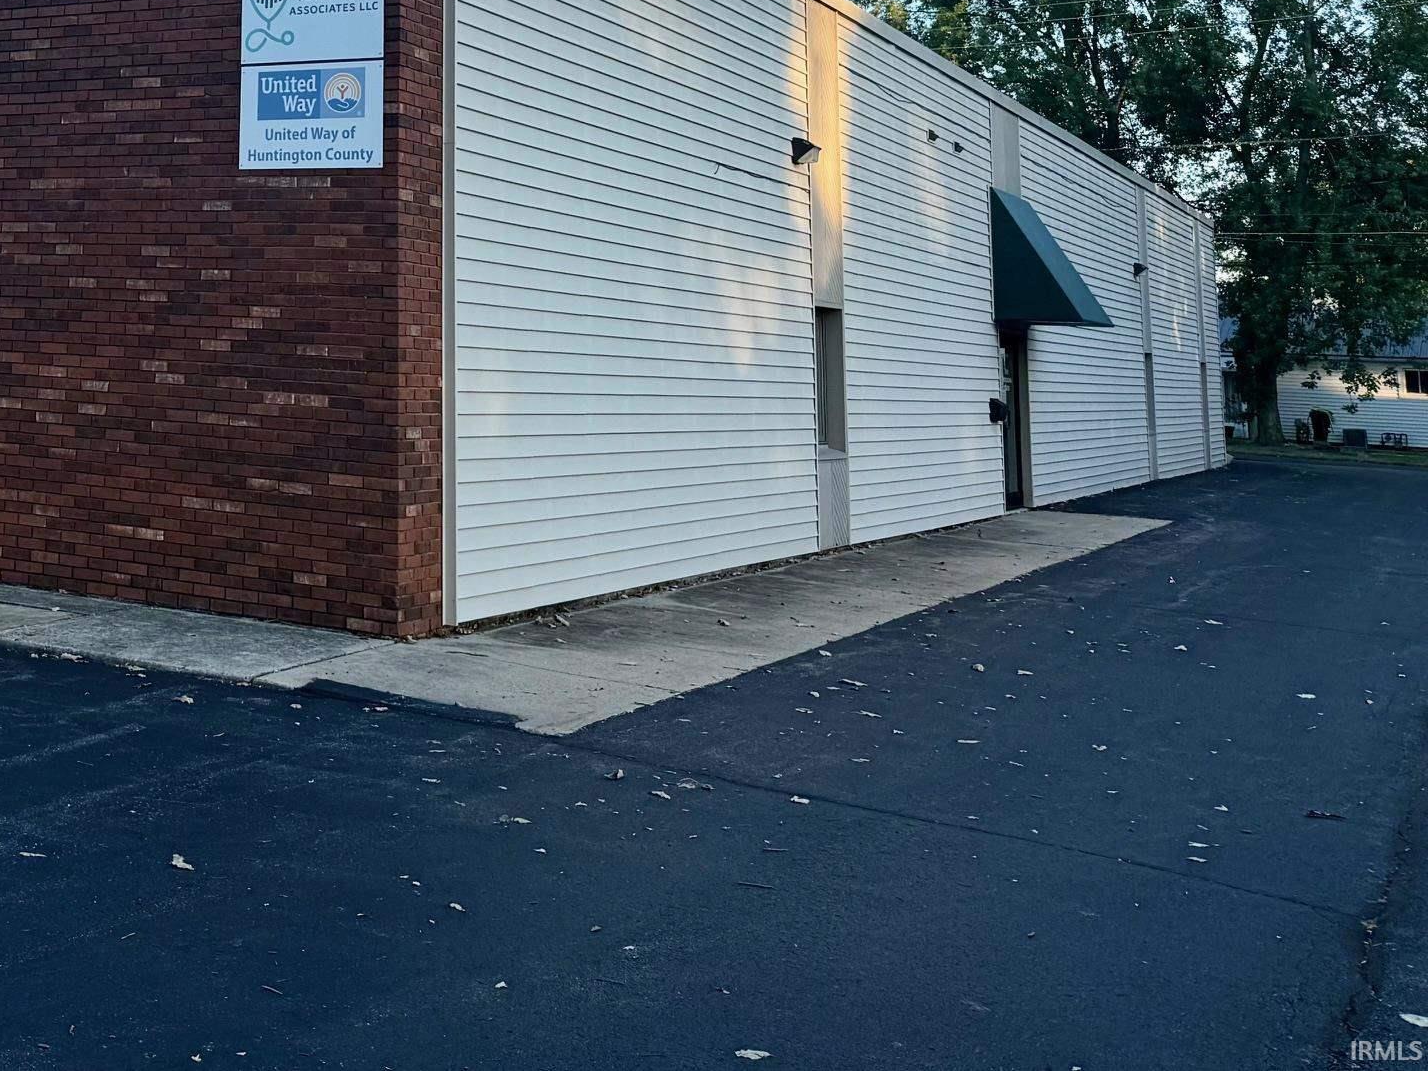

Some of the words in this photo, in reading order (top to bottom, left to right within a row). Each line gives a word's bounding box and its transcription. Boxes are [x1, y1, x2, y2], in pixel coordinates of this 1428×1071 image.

[289, 2, 355, 15] ASSOCIATES
[359, 1, 379, 11] LLC
[260, 74, 317, 94] United
[282, 95, 317, 116] Way
[265, 127, 308, 141] United
[311, 127, 339, 143] Way
[341, 126, 356, 139] of
[248, 148, 322, 164] Huntington
[325, 147, 374, 163] County
